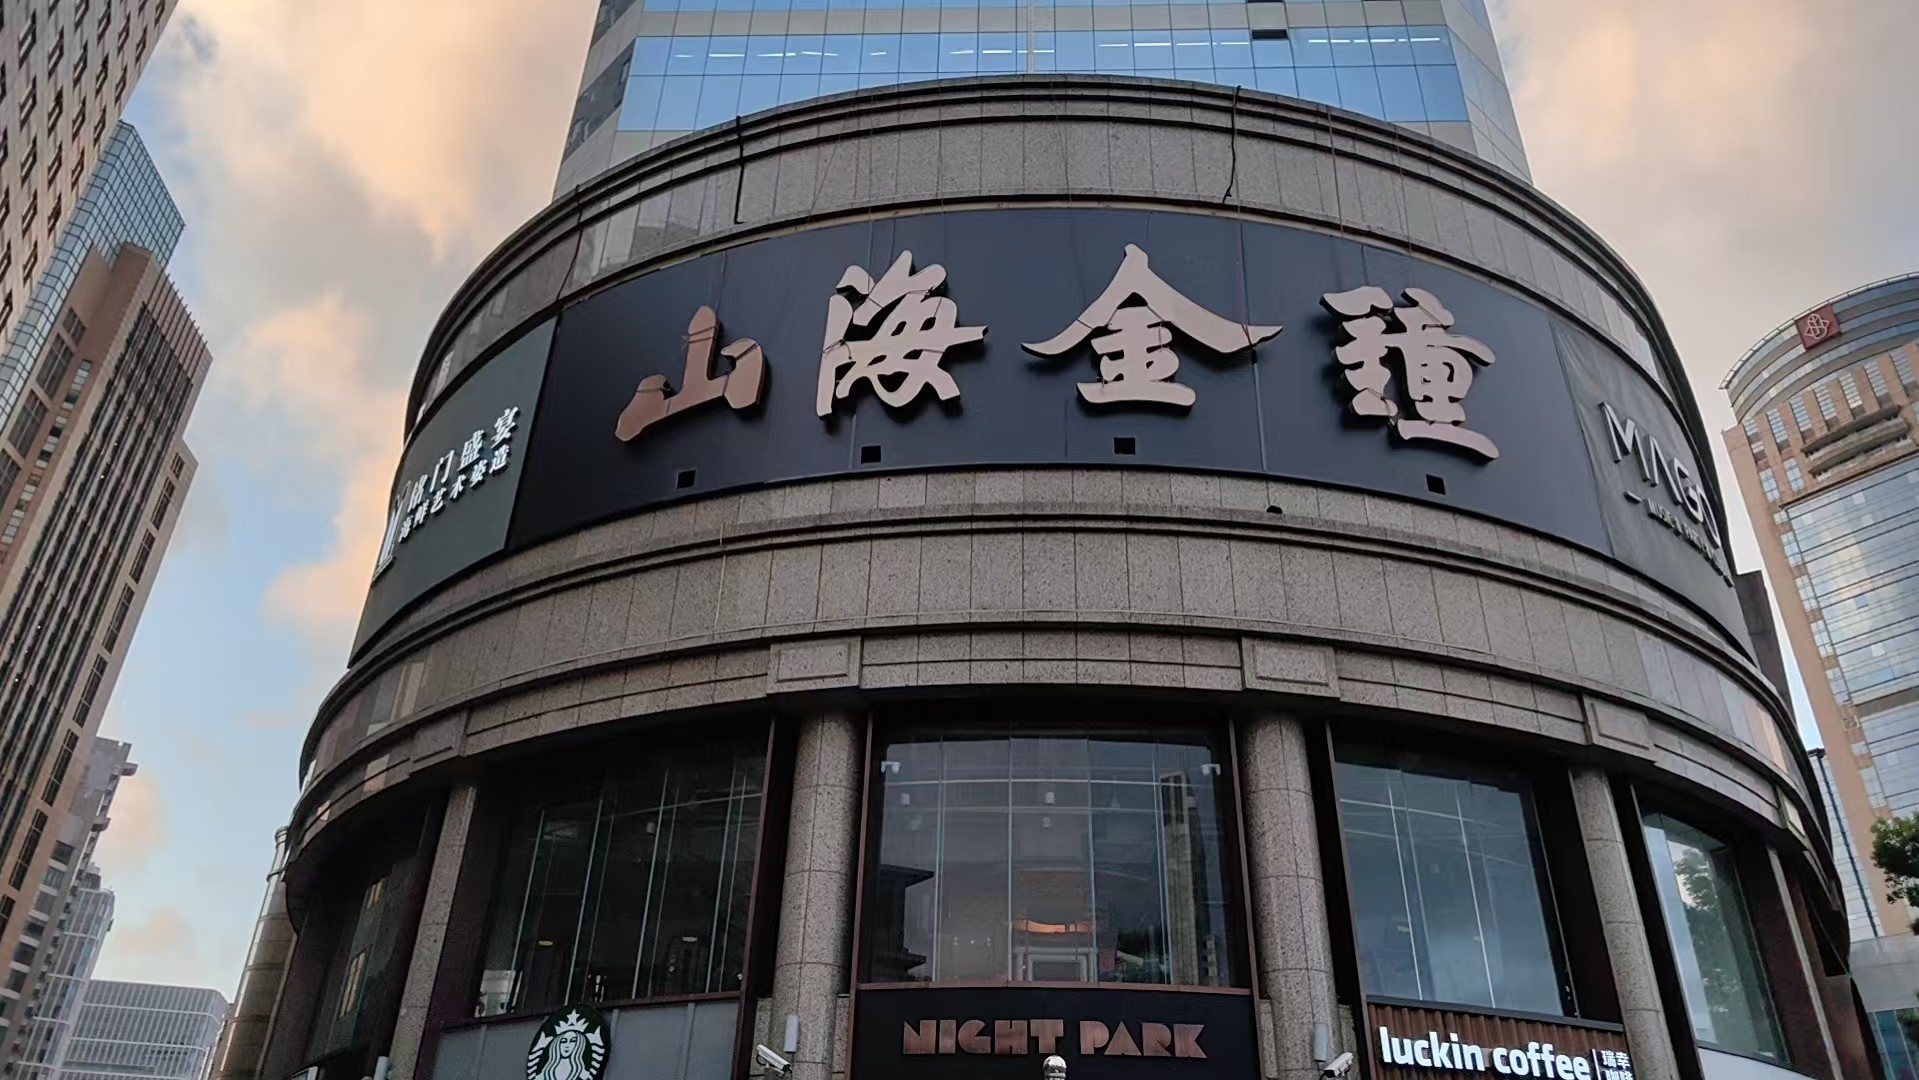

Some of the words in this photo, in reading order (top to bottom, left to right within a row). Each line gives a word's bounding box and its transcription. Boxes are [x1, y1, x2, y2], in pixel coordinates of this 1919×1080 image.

[902, 1019, 1064, 1055] NIGHT
[1079, 1020, 1208, 1059] PARK
[1379, 1026, 1486, 1072] luckin
[1492, 1041, 1591, 1080] coffee
[1601, 1050, 1631, 1069] 瑞幸
